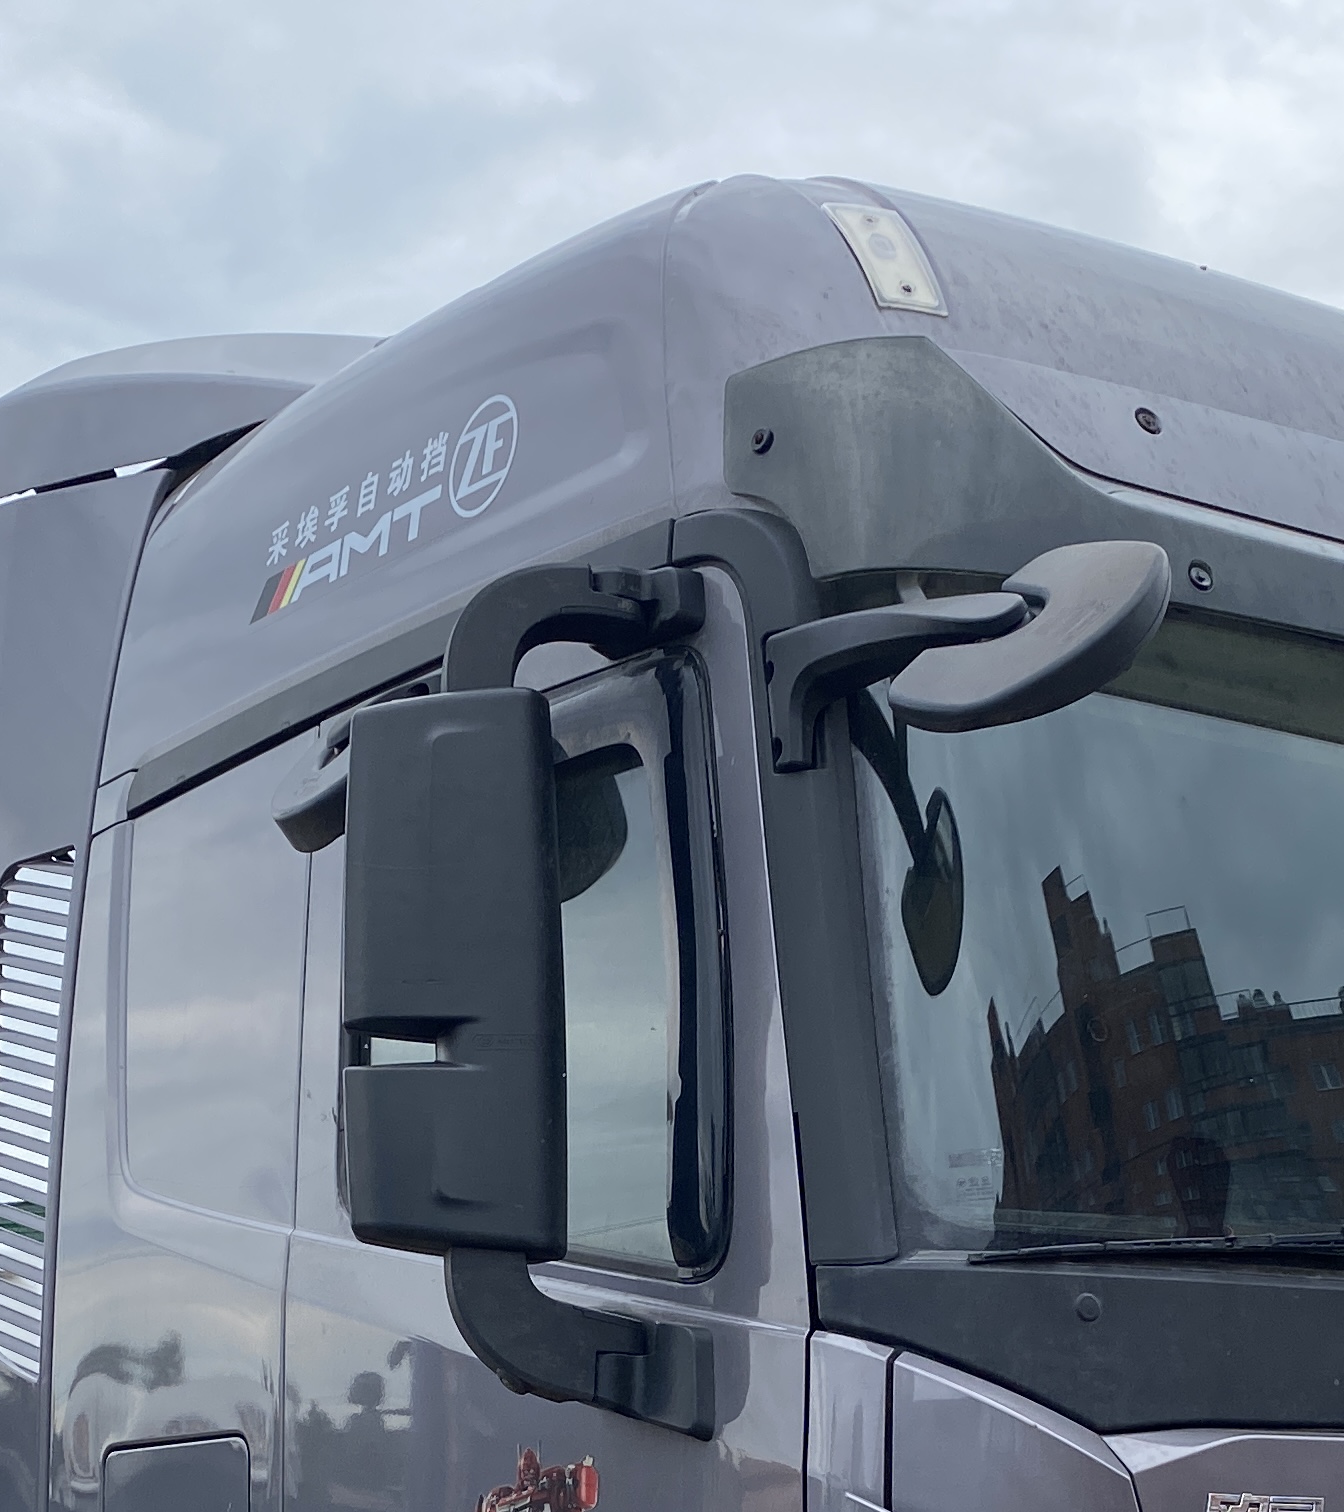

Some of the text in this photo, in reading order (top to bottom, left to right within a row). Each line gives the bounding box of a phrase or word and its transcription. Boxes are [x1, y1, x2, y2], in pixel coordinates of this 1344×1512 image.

[266, 431, 449, 566] 采埃孚自动挡
[452, 400, 517, 512] ZF
[290, 484, 442, 603] AMT
